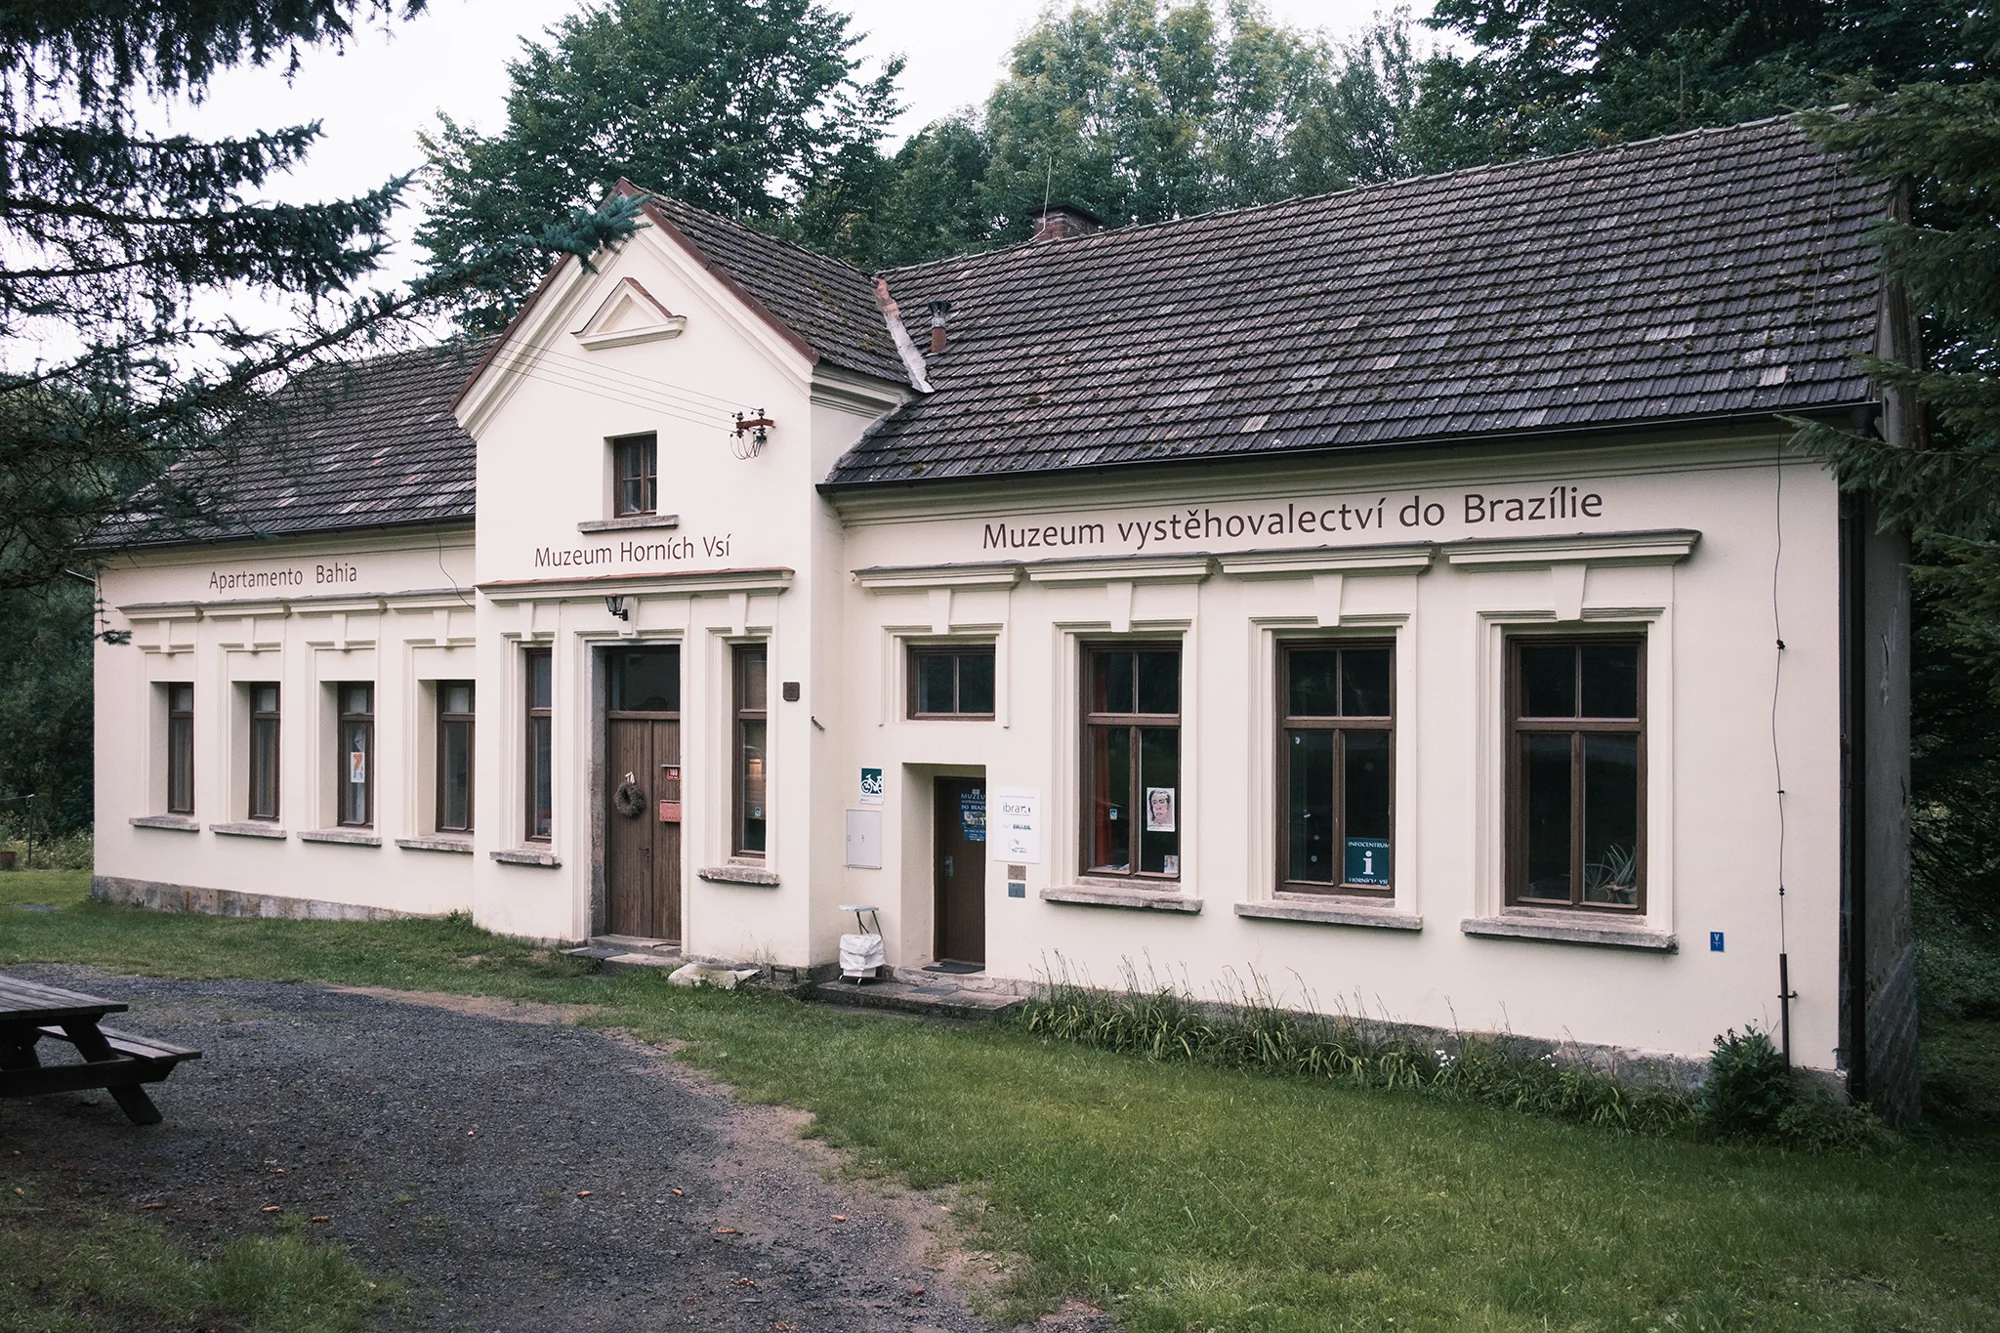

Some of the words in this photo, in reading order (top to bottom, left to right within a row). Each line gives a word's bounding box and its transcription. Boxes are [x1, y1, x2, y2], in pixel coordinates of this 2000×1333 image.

[983, 522, 1104, 549] Muzeum
[1117, 497, 1387, 550] vystěhovalectví
[1399, 495, 1445, 527] do
[1464, 486, 1603, 524] Brazílie
[534, 547, 612, 567] Muzeum
[620, 536, 694, 563] Horních
[703, 533, 732, 557] Vsí
[209, 570, 304, 594] Apartamento
[316, 562, 358, 584] Bahia
